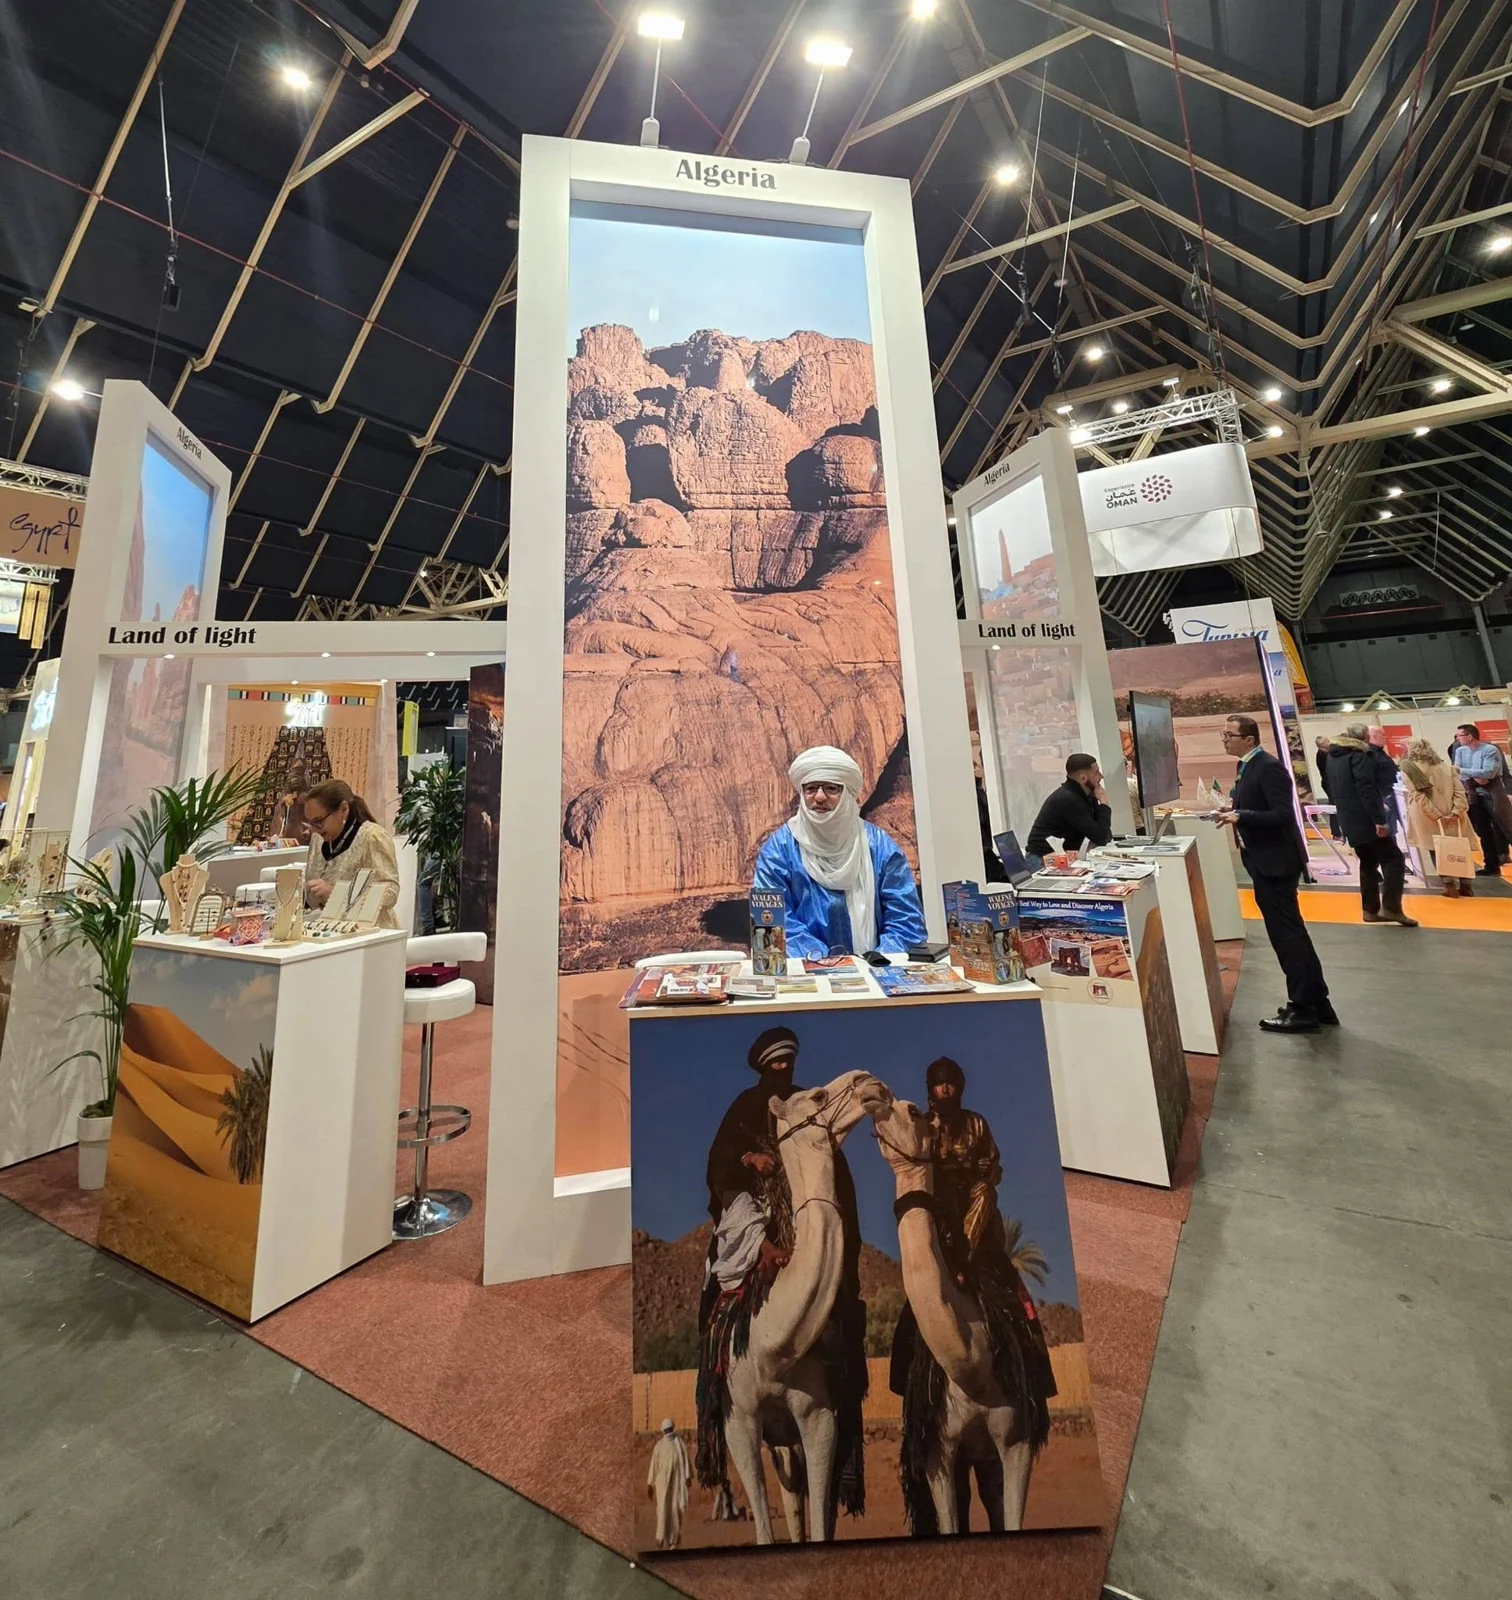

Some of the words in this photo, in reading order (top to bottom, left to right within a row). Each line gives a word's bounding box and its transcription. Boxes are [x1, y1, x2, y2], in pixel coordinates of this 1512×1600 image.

[676, 159, 777, 189] Algeria
[176, 426, 202, 460] Algeria
[984, 463, 1010, 487] Algeria
[1104, 483, 1135, 493] Experience
[1106, 497, 1138, 509] OMAN
[108, 626, 166, 644] Land
[174, 626, 199, 644] of
[205, 626, 257, 648] light
[978, 623, 1016, 638] Land
[1021, 623, 1036, 637] of
[1041, 623, 1076, 640] light
[987, 900, 1016, 911] VOYAGES
[1030, 900, 1042, 909] Way
[1060, 901, 1072, 909] and
[1072, 902, 1094, 910] Discover
[1094, 902, 1115, 912] Algeria
